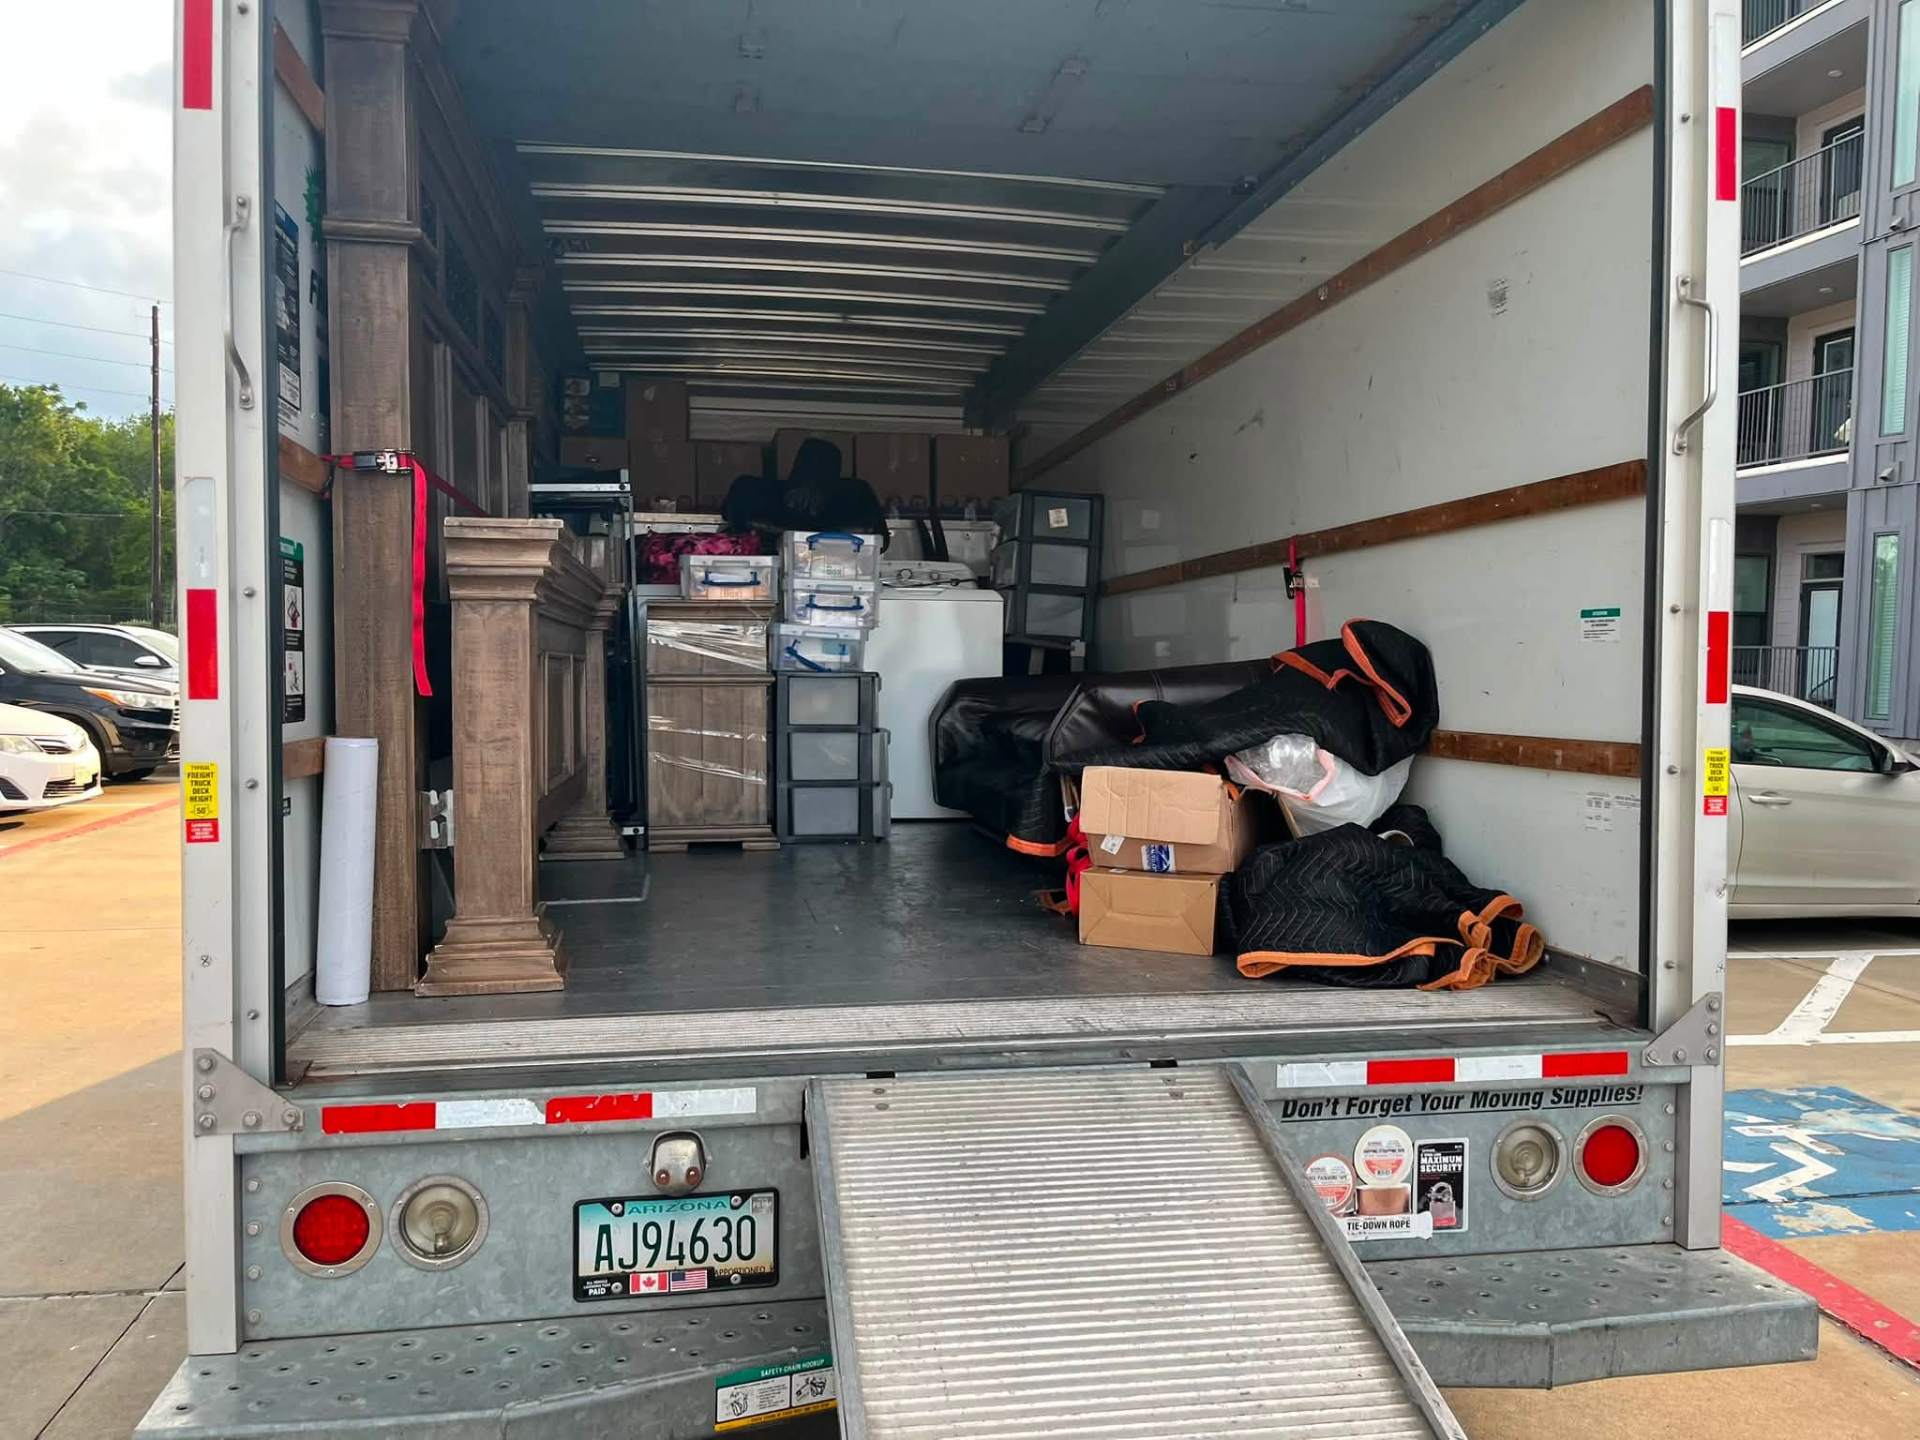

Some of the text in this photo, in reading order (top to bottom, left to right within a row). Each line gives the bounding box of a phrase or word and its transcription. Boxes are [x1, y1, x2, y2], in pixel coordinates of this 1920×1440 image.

[1282, 1084, 1645, 1119] Don't Forget Your Moving Supplies!
[1420, 1155, 1463, 1164] MAXIMUM
[1419, 1164, 1463, 1172] SECURITY
[628, 1200, 728, 1215] ARIZONA
[1347, 1219, 1411, 1231] TIE-DOWN ROPE
[594, 1215, 756, 1272] AJ94630
[588, 1287, 606, 1296] PAID
[760, 1367, 783, 1377] SAFETY
